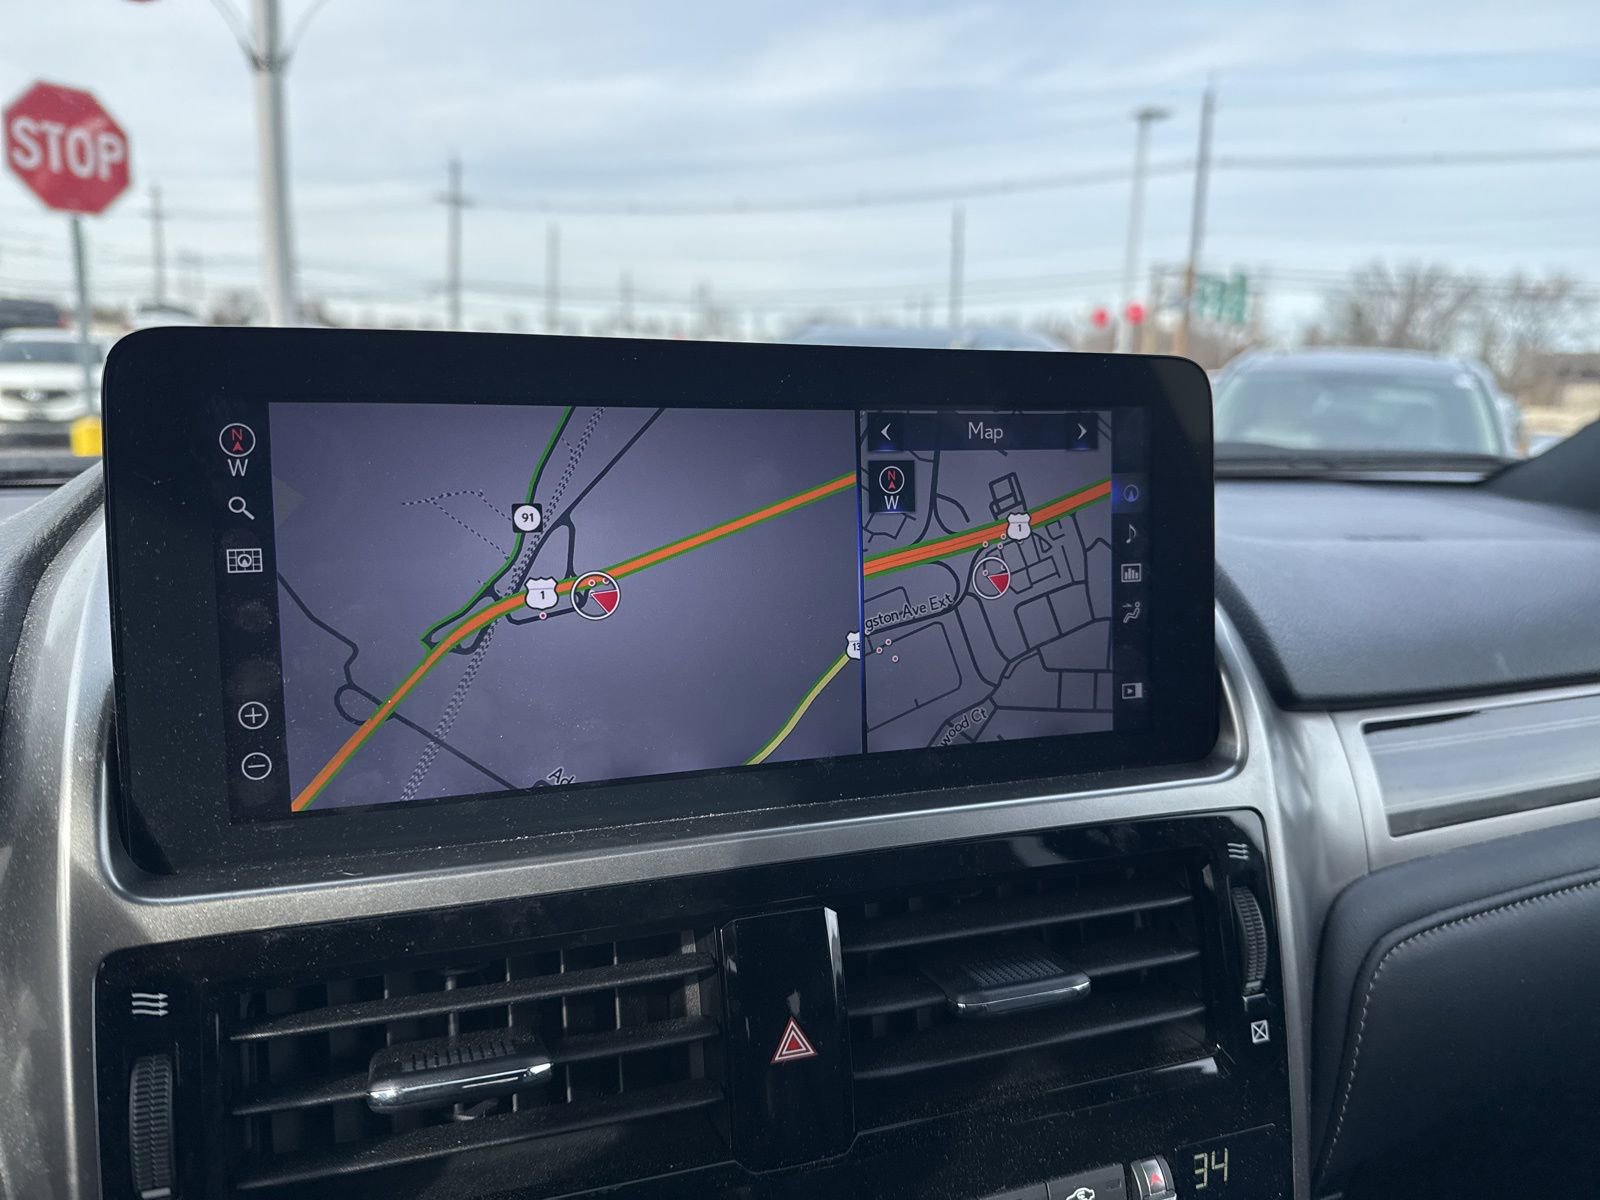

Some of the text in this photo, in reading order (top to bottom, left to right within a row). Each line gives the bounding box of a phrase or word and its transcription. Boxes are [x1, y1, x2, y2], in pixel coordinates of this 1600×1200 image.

[11, 117, 124, 181] STOP
[231, 429, 243, 441] N
[967, 421, 1004, 444] Map
[227, 458, 249, 477] W
[887, 470, 896, 481] N
[884, 495, 899, 510] W
[521, 512, 534, 523] 91
[865, 594, 952, 632] gston Ave Ext
[971, 708, 987, 722] Ct
[1194, 1147, 1228, 1189] 34
